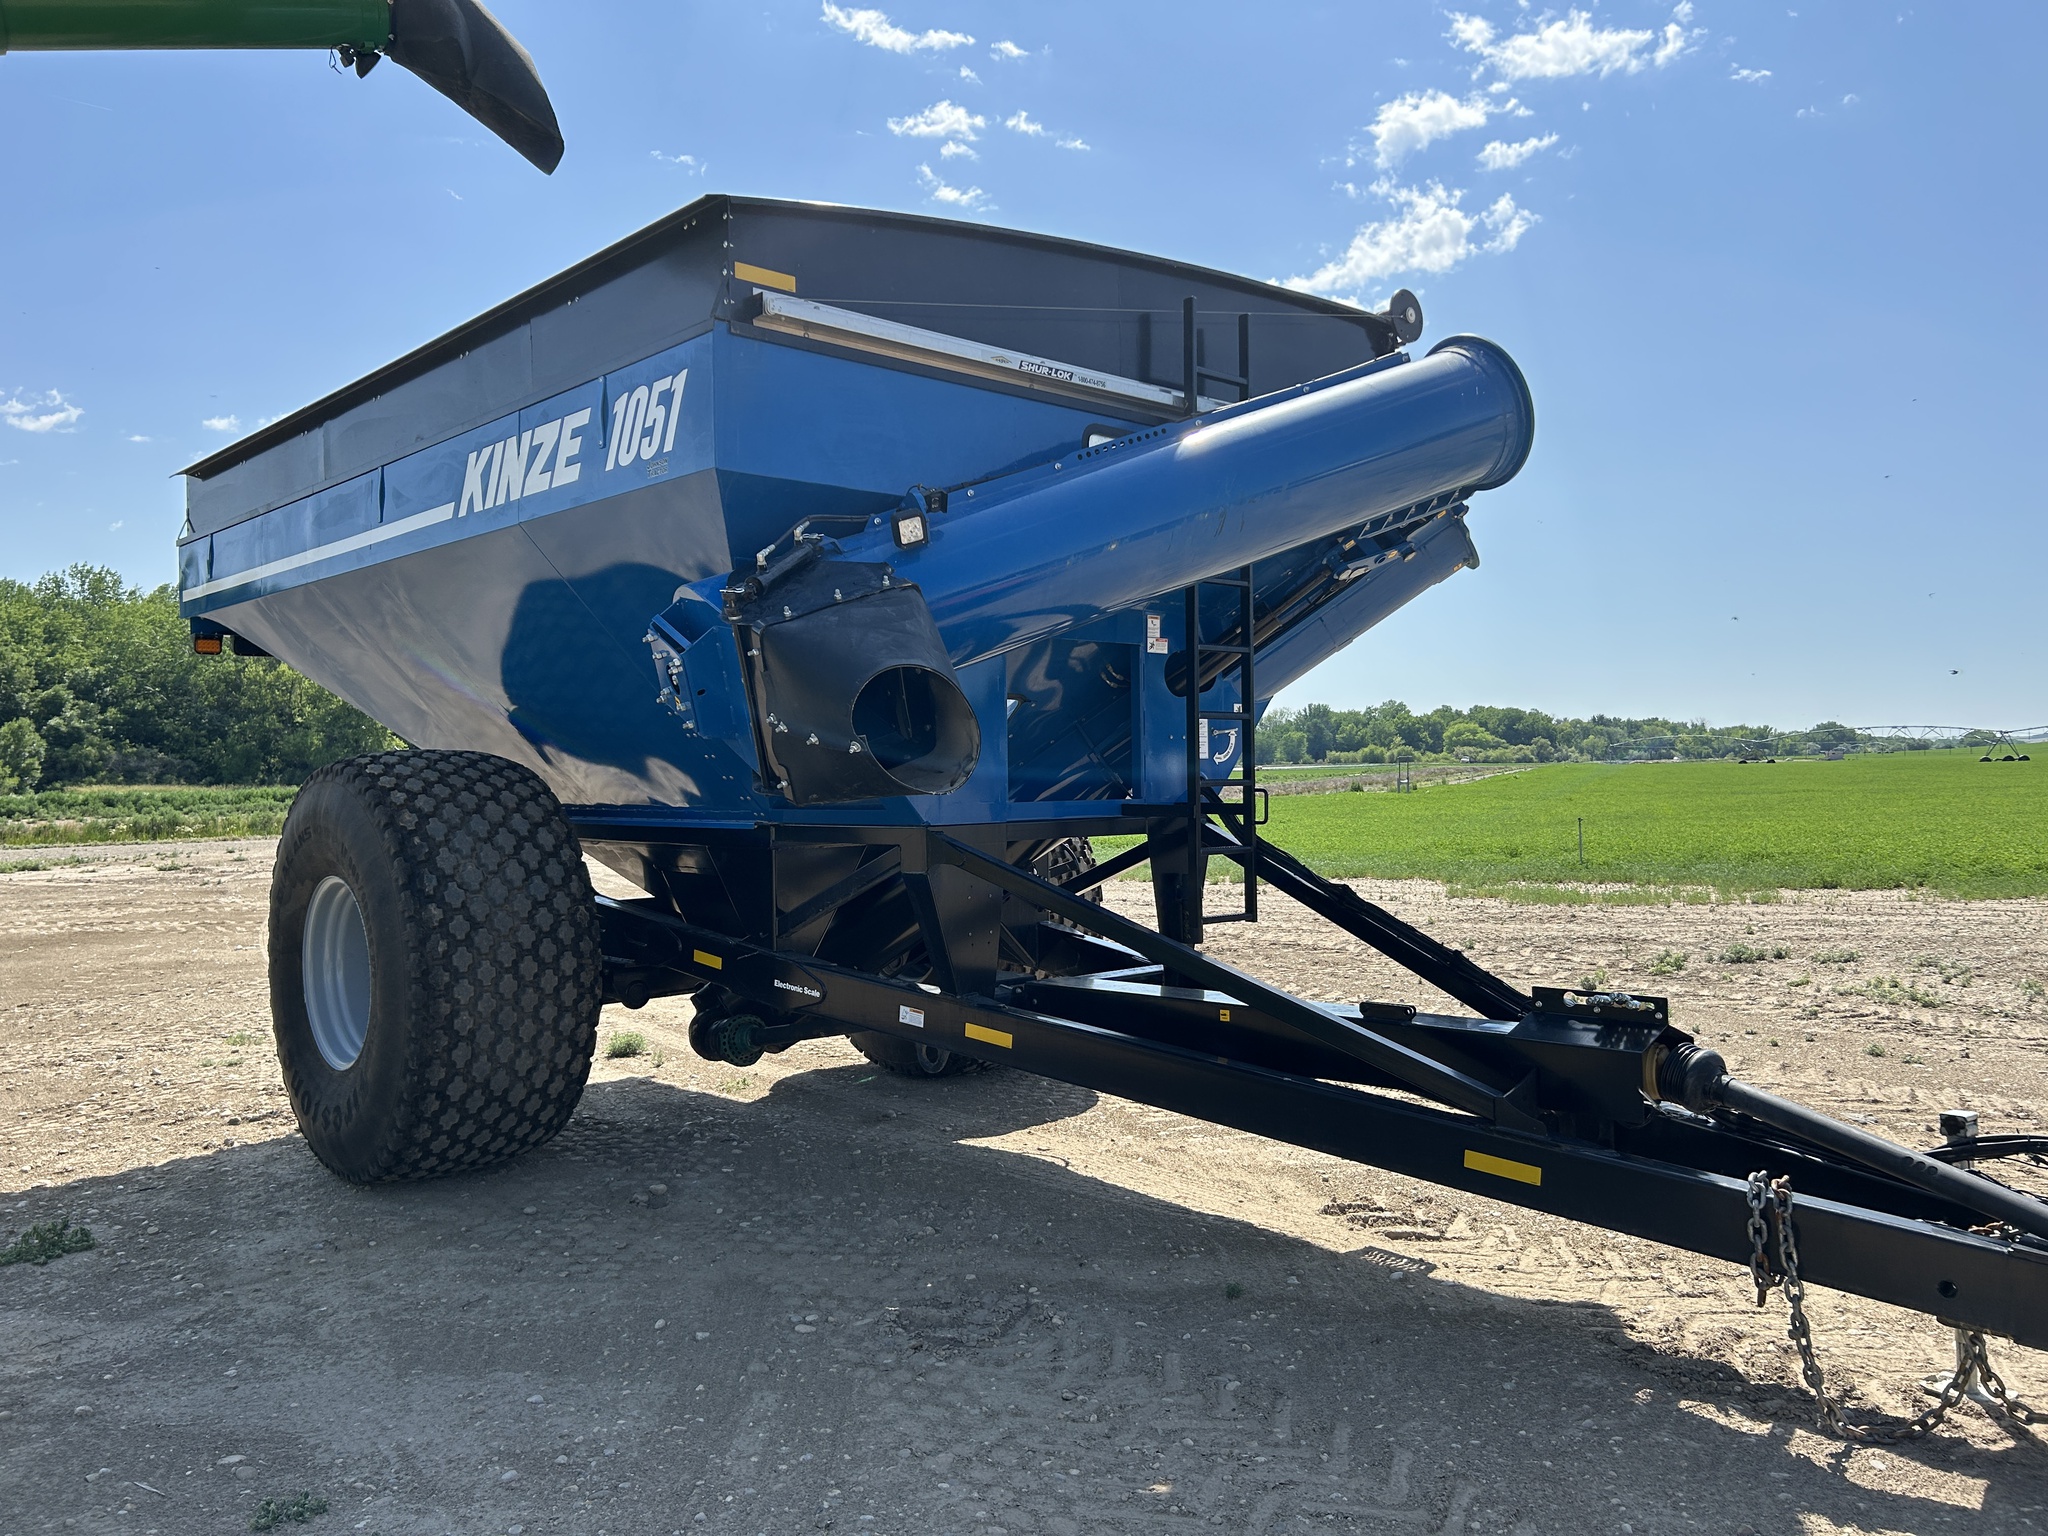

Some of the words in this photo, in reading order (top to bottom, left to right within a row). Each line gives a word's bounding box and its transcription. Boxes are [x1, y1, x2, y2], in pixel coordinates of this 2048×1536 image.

[458, 407, 591, 518] KINZE
[605, 368, 688, 472] 1051
[774, 979, 803, 993] Electronic
[803, 986, 821, 998] Scale
